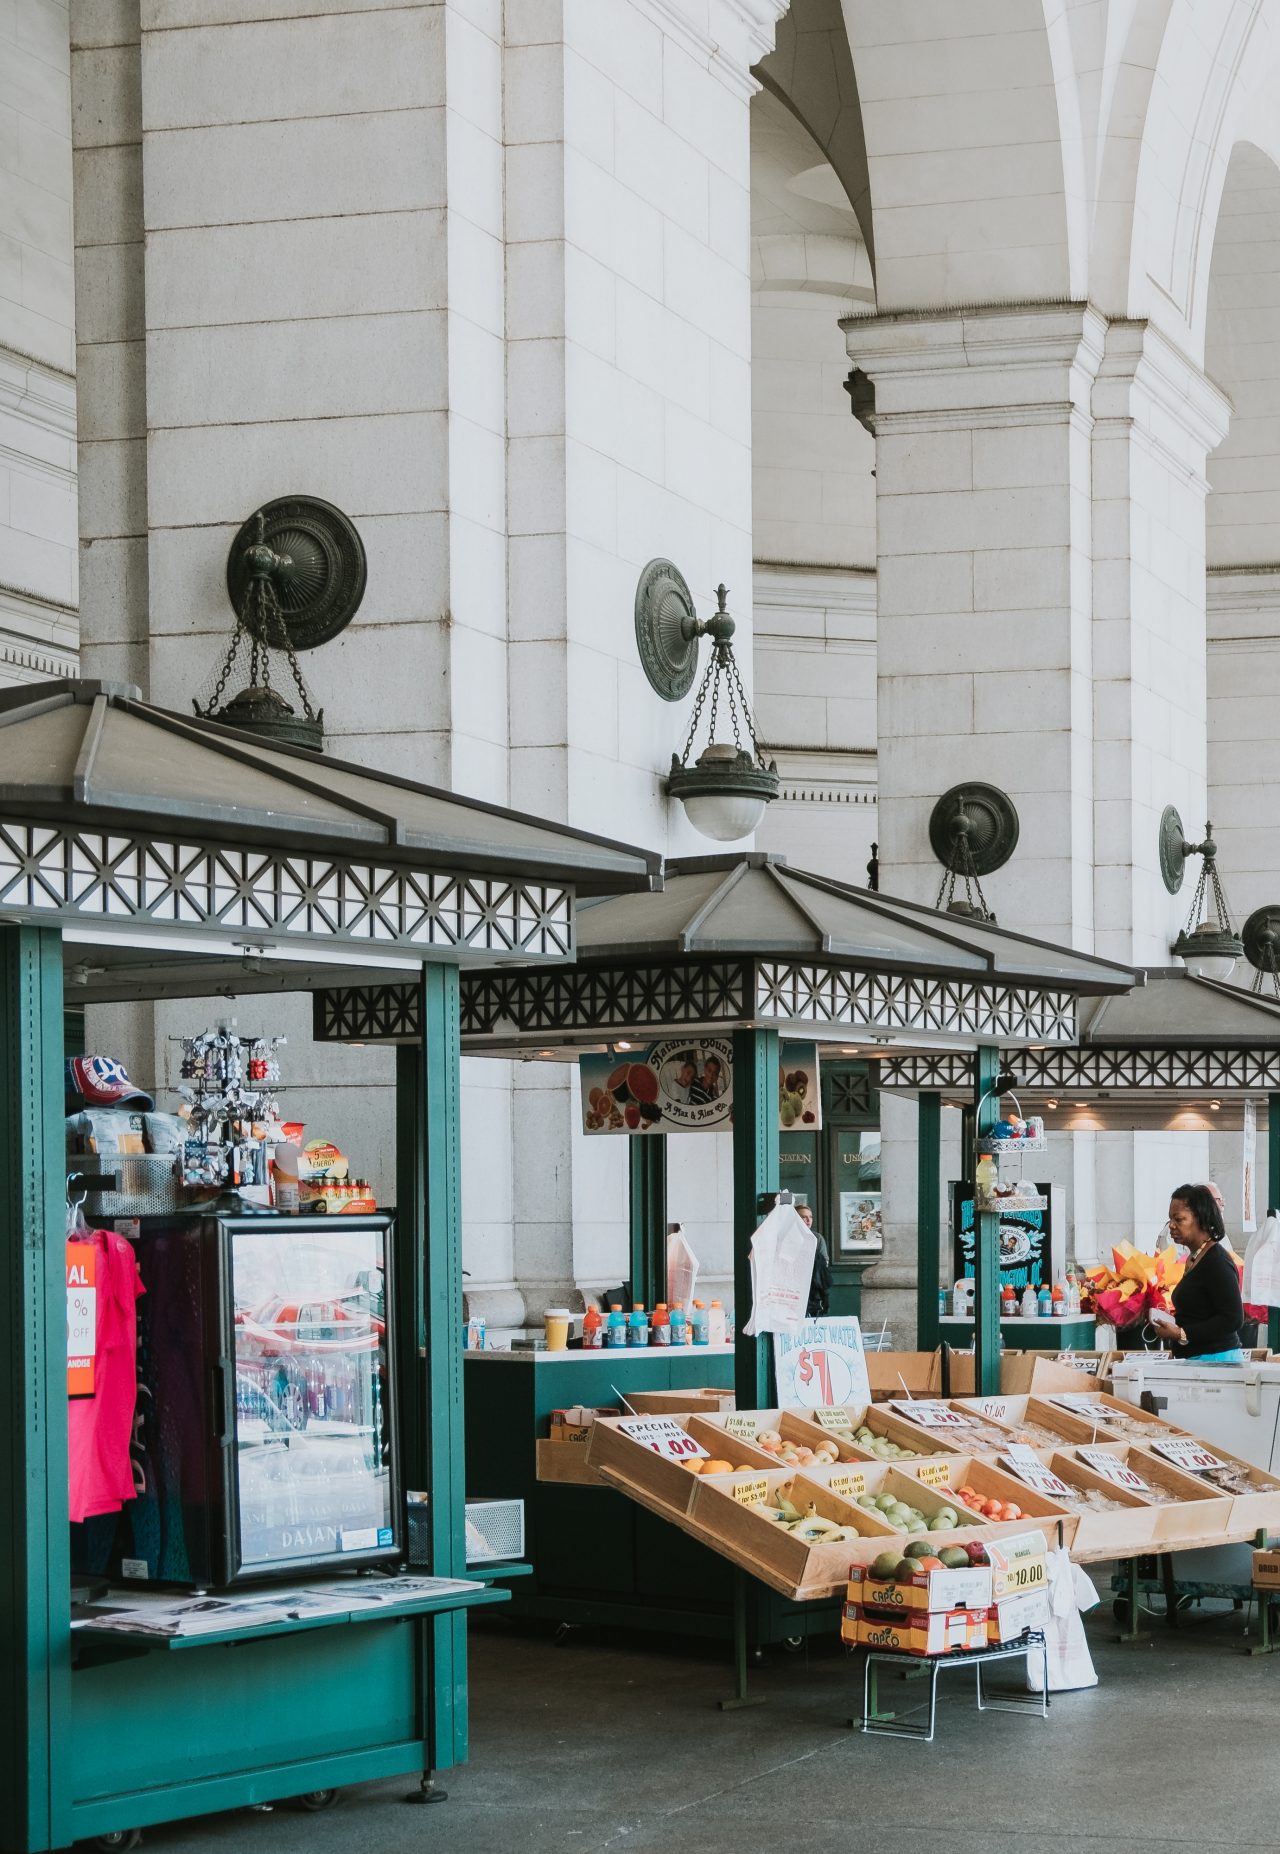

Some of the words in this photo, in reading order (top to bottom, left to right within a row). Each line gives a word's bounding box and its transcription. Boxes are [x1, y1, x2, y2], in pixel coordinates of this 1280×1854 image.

[651, 1039, 695, 1070] Natures
[700, 1038, 733, 1064] Bount
[673, 1108, 688, 1118] Max
[697, 1108, 714, 1121] Alex
[313, 1159, 336, 1169] ENERGY
[73, 1327, 90, 1338] OFF
[779, 1332, 794, 1357] THE
[830, 1325, 860, 1352] WATER
[799, 1347, 835, 1406] $1
[628, 1421, 678, 1433] SPECIAL
[664, 1430, 686, 1438] MORE
[568, 1433, 589, 1442] CAPC
[650, 1438, 698, 1456] 1.00
[1007, 1458, 1048, 1472] SECIAL
[282, 1523, 344, 1548] DASANI
[1015, 1564, 1043, 1586] 10.00
[1258, 1564, 1279, 1574] DRIED
[872, 1591, 904, 1605] CAPCO
[867, 1631, 900, 1647] CAPCO
